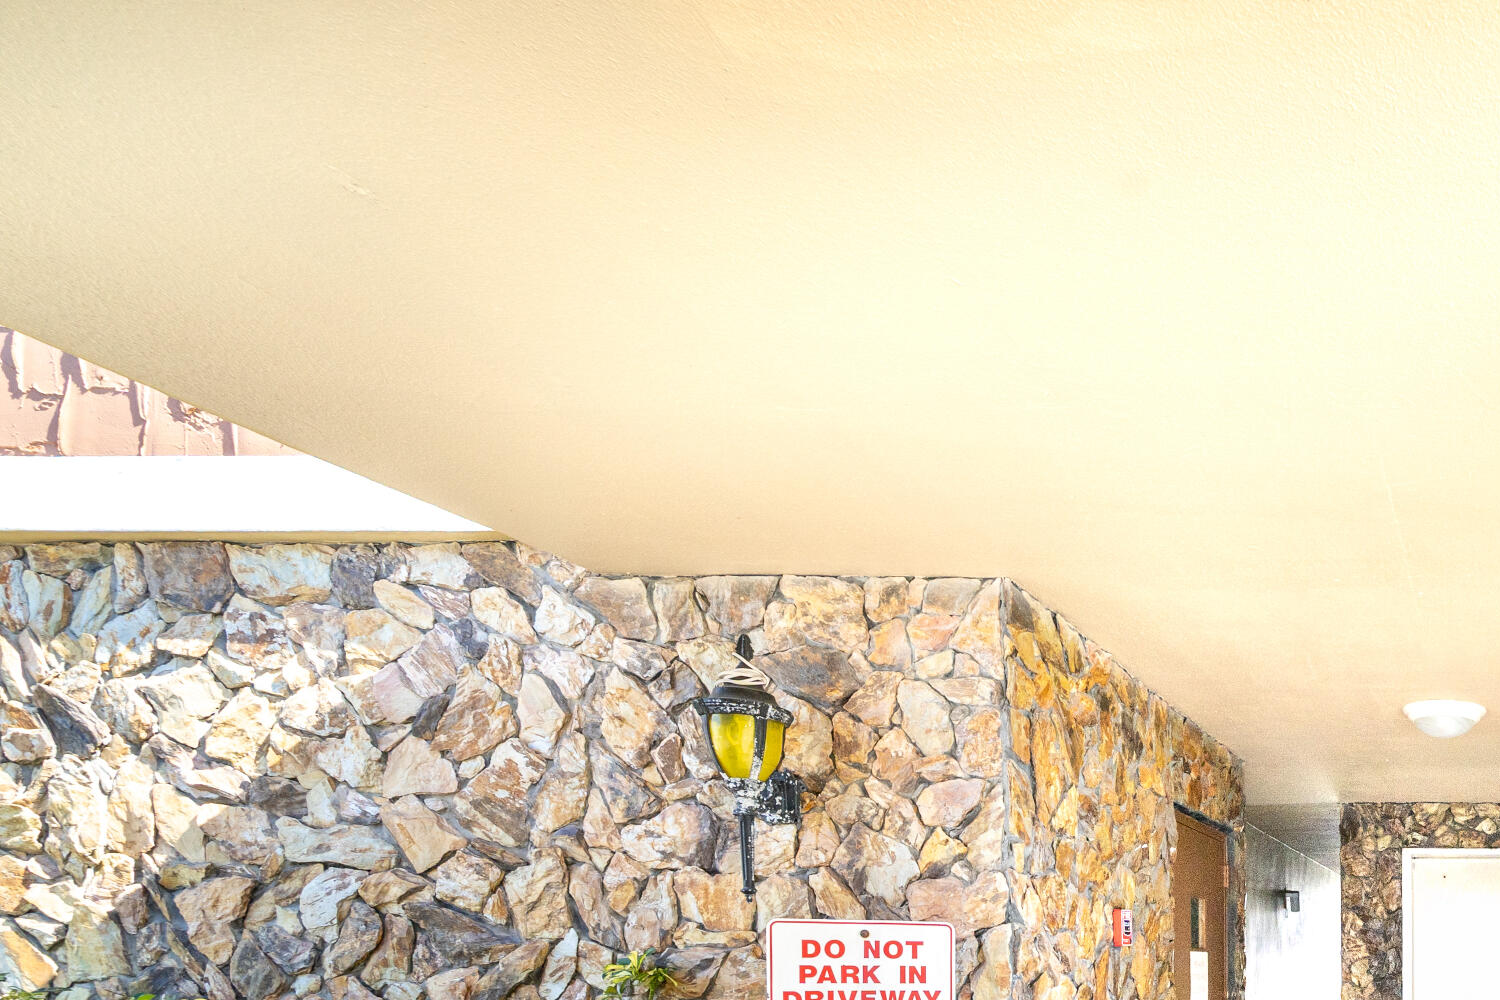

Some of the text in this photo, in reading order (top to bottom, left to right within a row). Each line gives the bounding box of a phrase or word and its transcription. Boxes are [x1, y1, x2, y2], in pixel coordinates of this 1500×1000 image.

[801, 939, 924, 959] DO NOT
[799, 965, 927, 984] PARK IN
